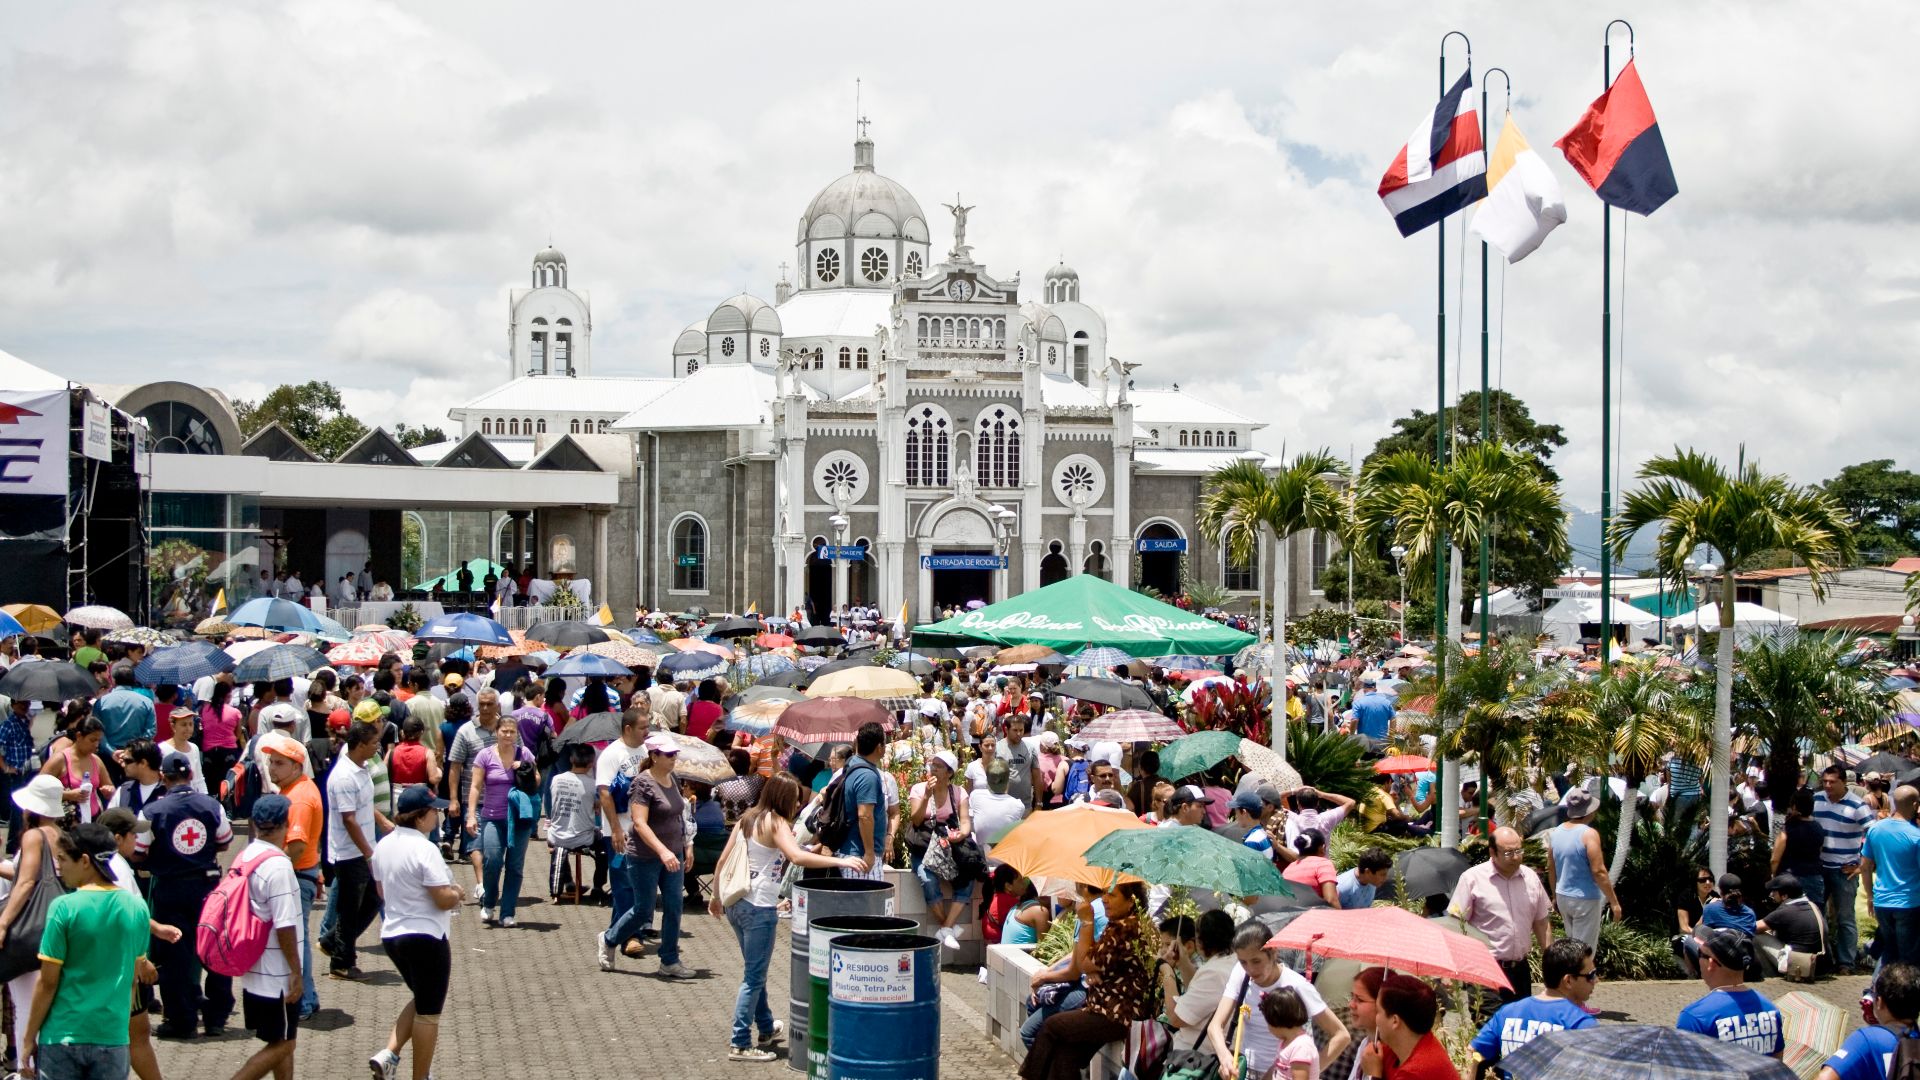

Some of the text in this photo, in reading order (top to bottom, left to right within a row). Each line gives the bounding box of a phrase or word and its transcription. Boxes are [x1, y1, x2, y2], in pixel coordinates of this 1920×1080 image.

[933, 558, 965, 566] ENTRADA
[965, 558, 975, 566] DE
[846, 963, 889, 973] RESIDUOS
[849, 973, 887, 983] Aluminio,
[864, 984, 885, 993] Tetra
[887, 984, 907, 992] Pack
